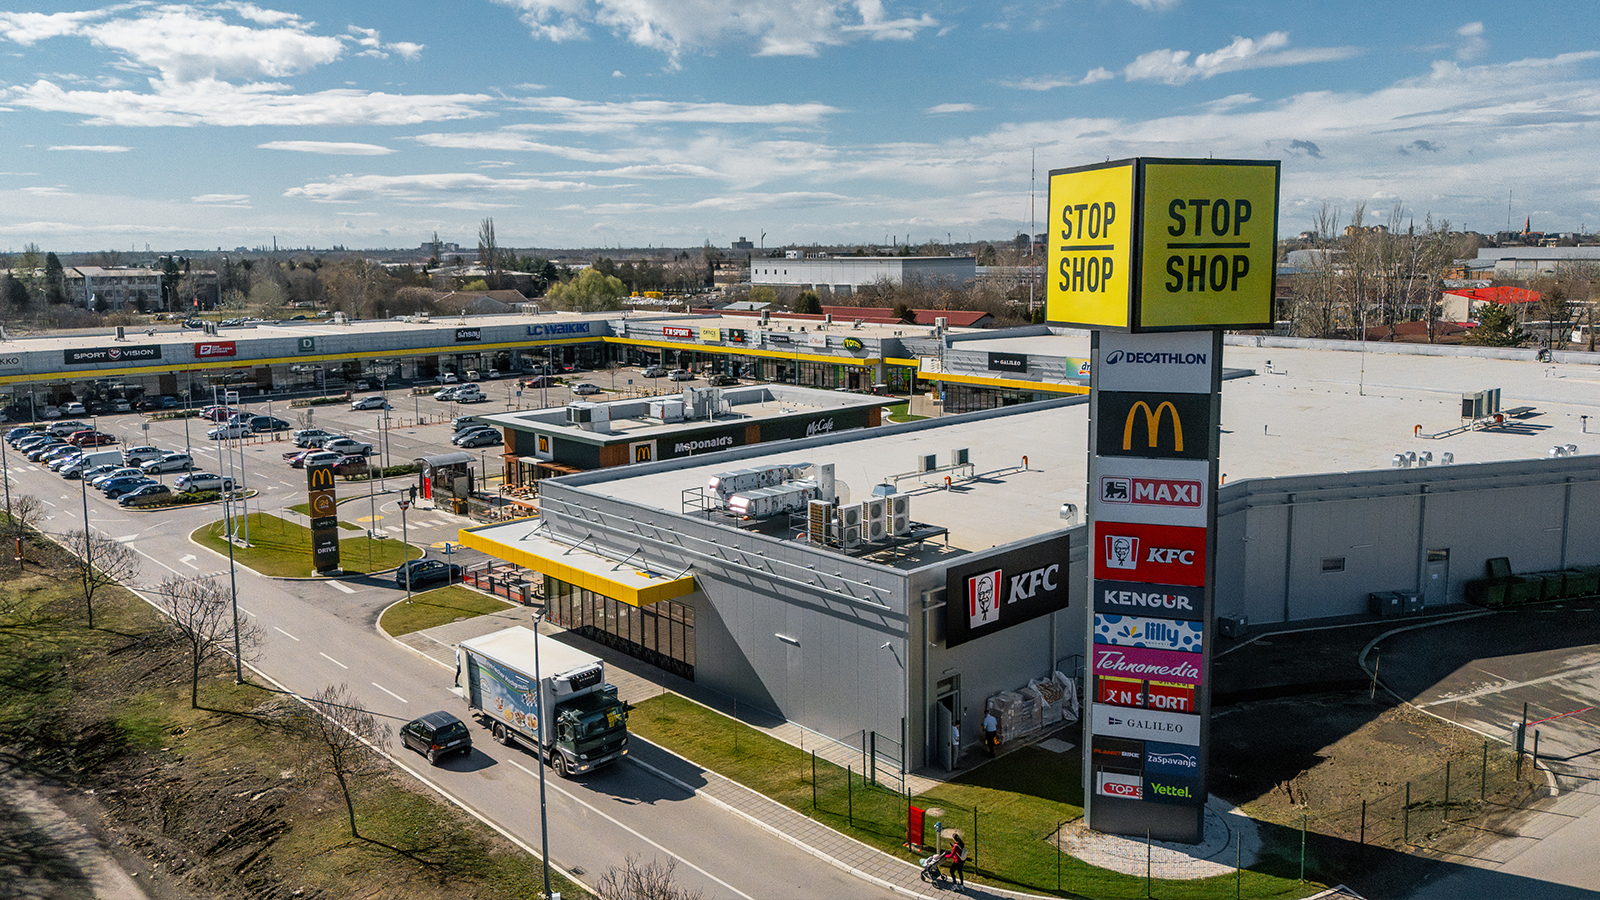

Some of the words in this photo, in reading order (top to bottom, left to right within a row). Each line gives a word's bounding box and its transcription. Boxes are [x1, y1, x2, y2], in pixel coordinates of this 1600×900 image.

[1061, 201, 1116, 240] STOP
[1167, 198, 1252, 237] STOP
[1059, 256, 1114, 293] SHOP
[1165, 254, 1250, 293] SHOP
[528, 325, 543, 336] LC
[303, 339, 312, 348] D
[73, 352, 107, 360] SPORT
[123, 349, 154, 357] VISION
[1000, 359, 1022, 367] GALILEO
[1126, 352, 1207, 365] DECATHLON
[806, 417, 834, 436] McCafé
[674, 436, 733, 453] McDonald's
[1135, 482, 1199, 503] MAXI
[317, 546, 337, 554] DRIVE
[1147, 547, 1195, 565] KFC
[1007, 563, 1060, 605] KFC
[1104, 590, 1193, 611] KENGUR
[1145, 621, 1179, 647] lilly
[1096, 651, 1199, 679] Tehnomedia
[1127, 718, 1184, 733] GALILEO
[1109, 783, 1133, 795] TOP
